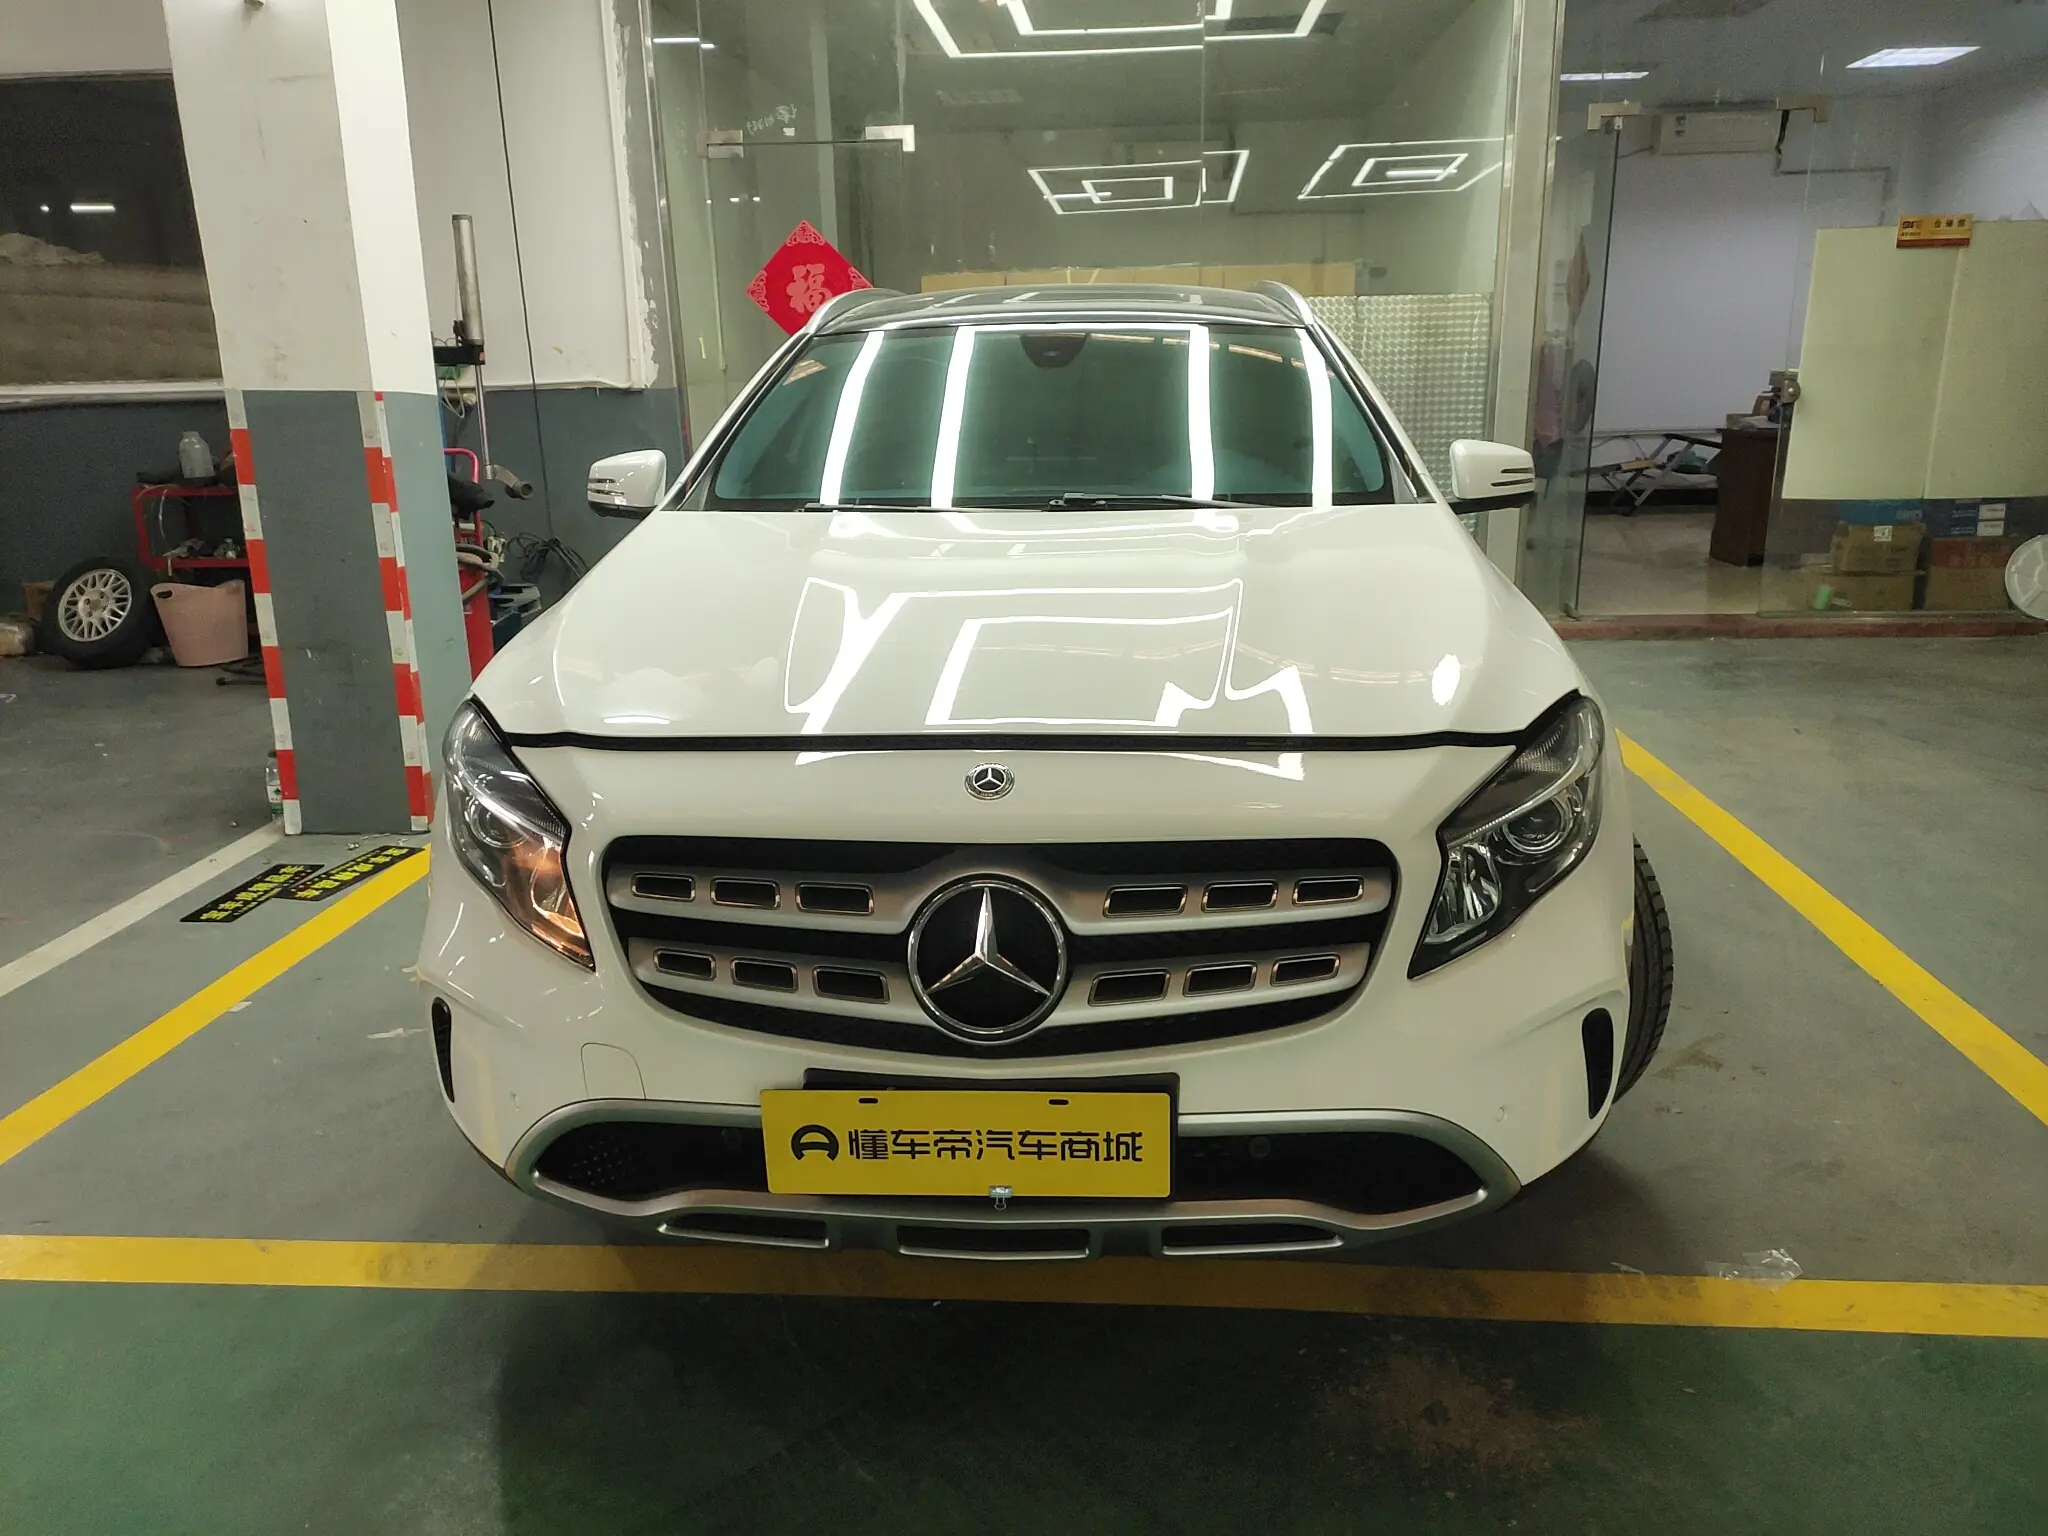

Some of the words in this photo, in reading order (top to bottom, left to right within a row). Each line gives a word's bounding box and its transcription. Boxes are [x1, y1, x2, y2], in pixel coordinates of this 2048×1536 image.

[786, 263, 833, 313] 福
[848, 1128, 1143, 1162] 懂车帝汽车商城
